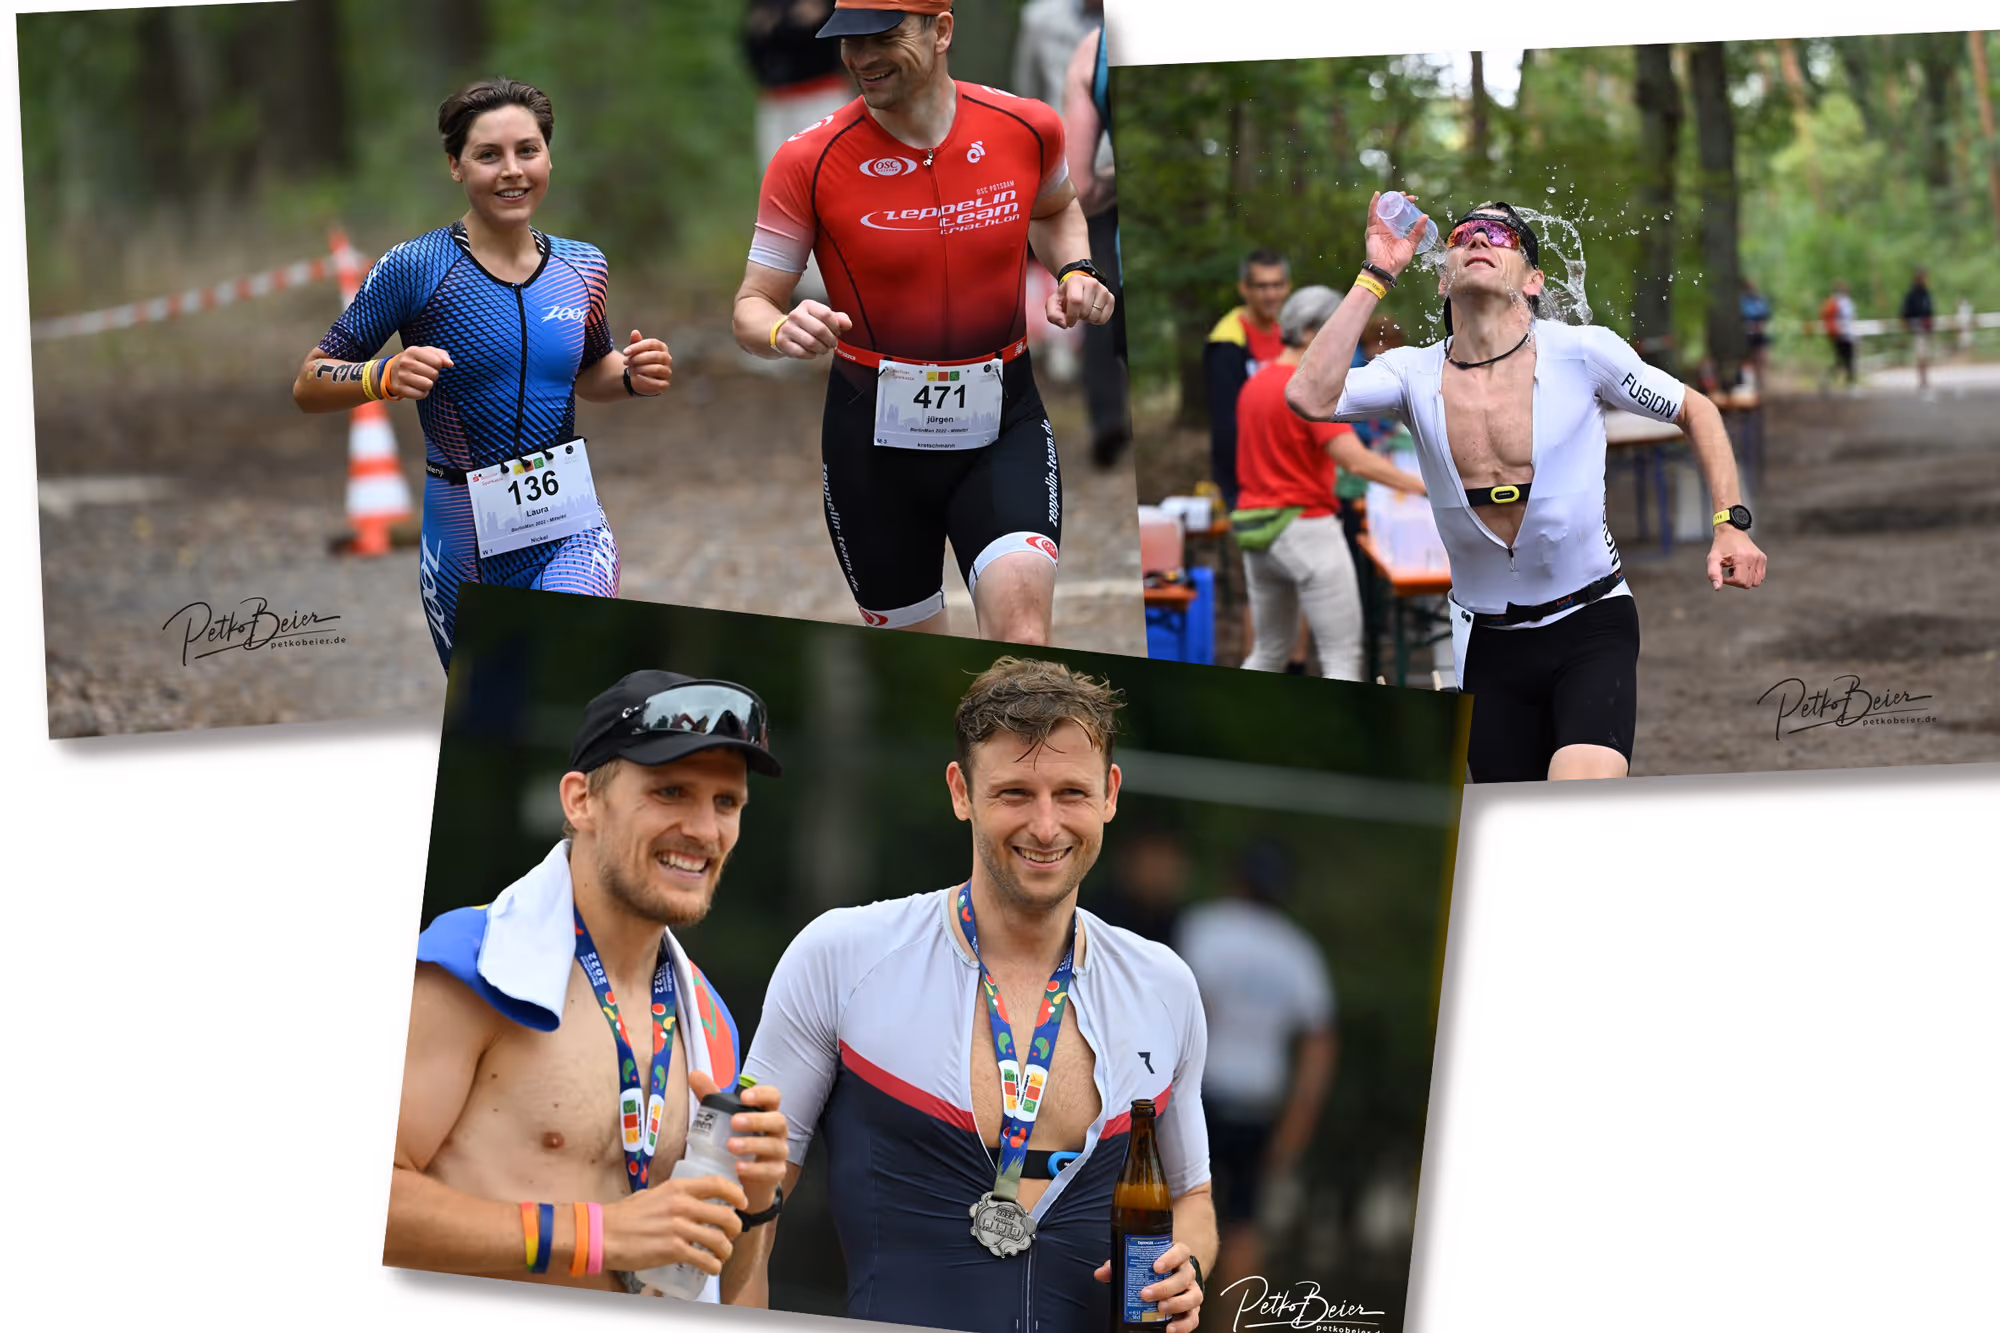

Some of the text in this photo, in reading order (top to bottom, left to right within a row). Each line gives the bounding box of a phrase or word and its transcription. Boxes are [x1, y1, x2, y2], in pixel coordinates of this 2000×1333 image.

[876, 160, 898, 170] OSC
[913, 384, 966, 409] 471
[1621, 372, 1677, 418] FUSION
[926, 416, 954, 425] jürgen
[1041, 419, 1060, 528] zeppelin-team.de
[507, 470, 560, 506] 136
[526, 506, 549, 517] Laura
[530, 535, 549, 543] Nickel
[822, 463, 859, 592] zeppelin-team.de
